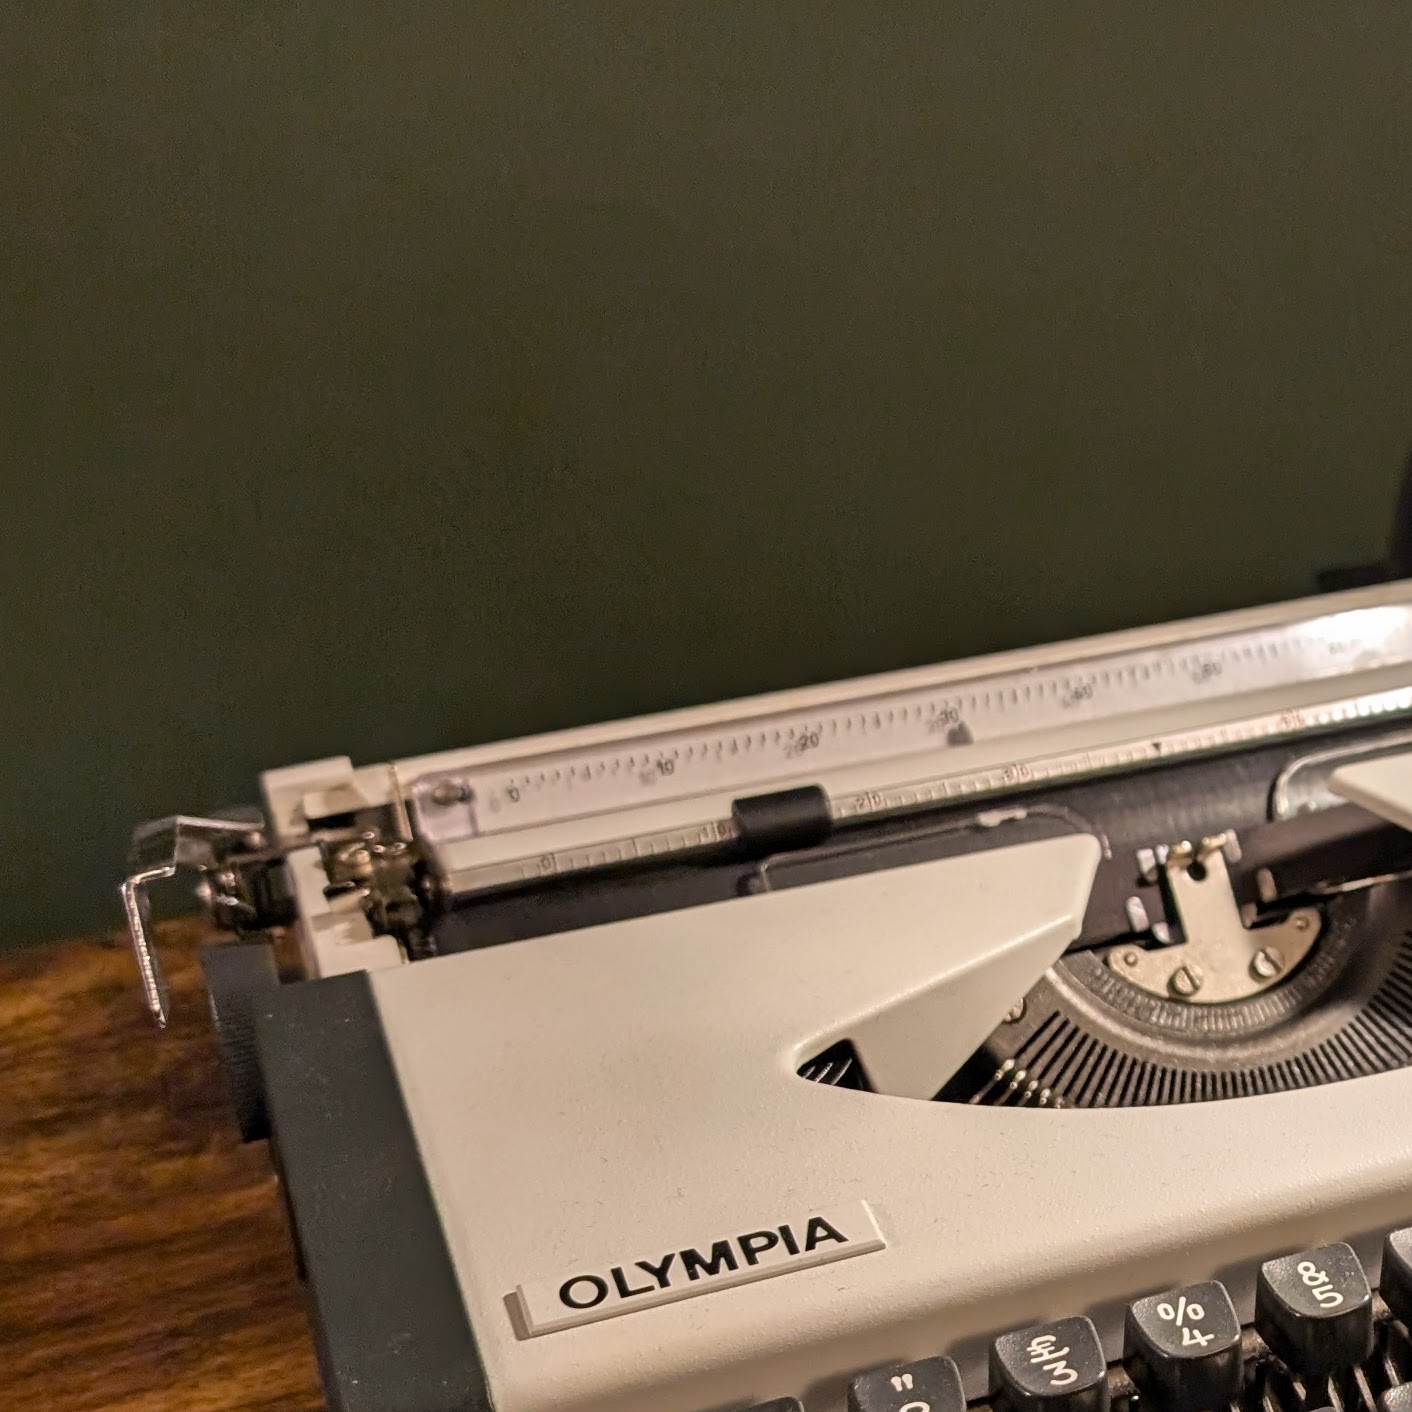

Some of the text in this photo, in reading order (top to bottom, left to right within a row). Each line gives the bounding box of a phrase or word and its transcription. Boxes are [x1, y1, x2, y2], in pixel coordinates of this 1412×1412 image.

[656, 758, 675, 777] 10
[508, 786, 520, 803] 0
[559, 1216, 848, 1309] OLYMPIA
[1297, 1261, 1328, 1285] &
[1312, 1285, 1343, 1309] 5
[1157, 1297, 1205, 1326] %
[1182, 1327, 1214, 1348] 4
[1043, 1358, 1078, 1385] 3
